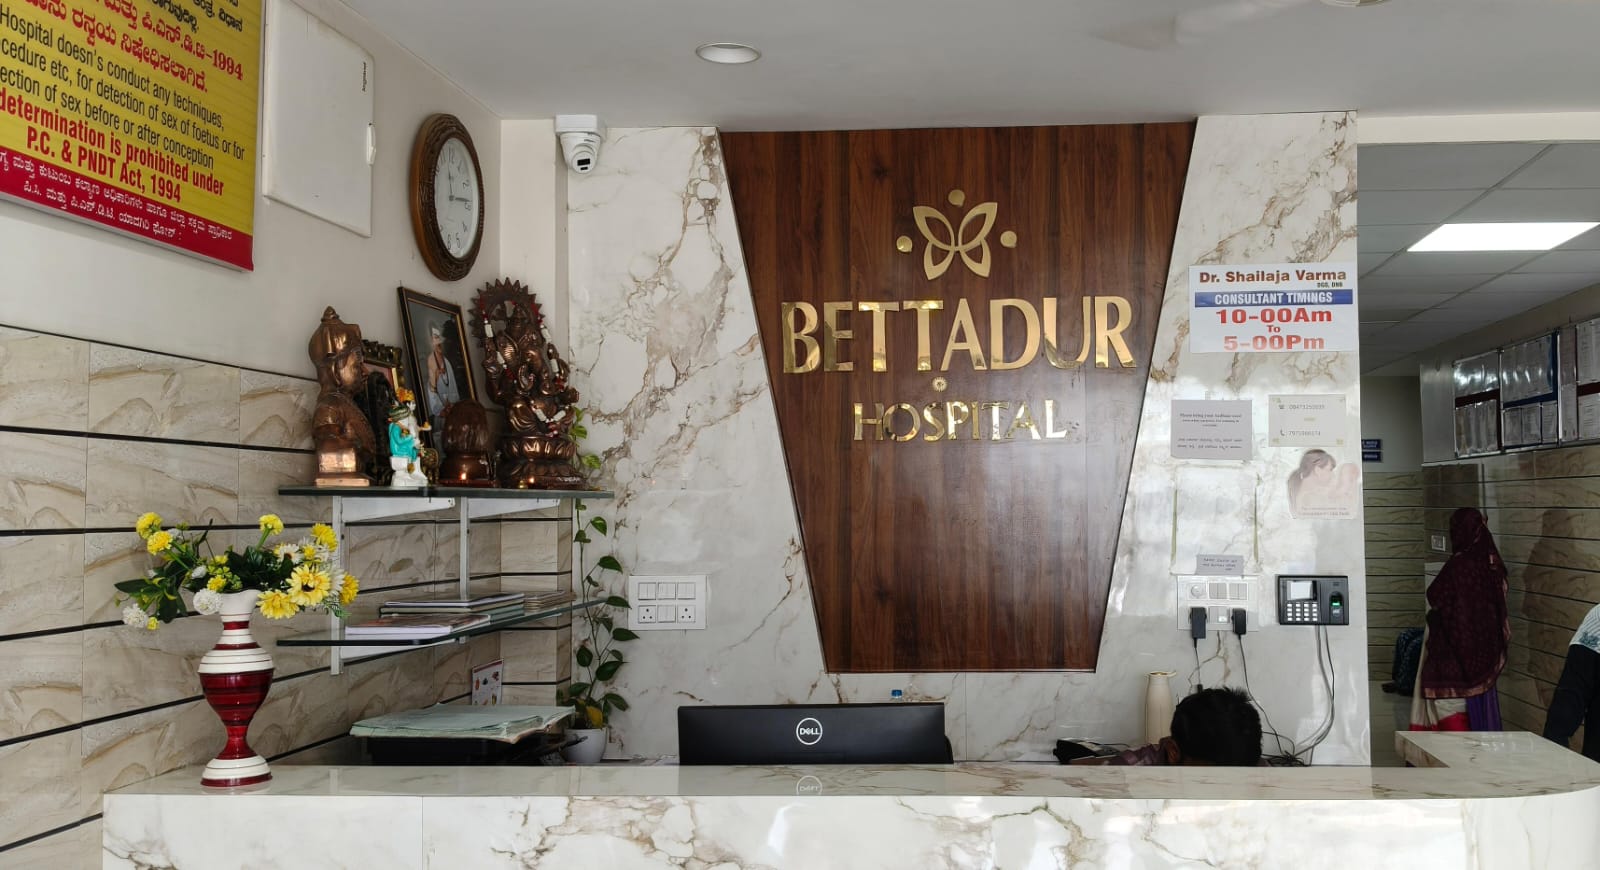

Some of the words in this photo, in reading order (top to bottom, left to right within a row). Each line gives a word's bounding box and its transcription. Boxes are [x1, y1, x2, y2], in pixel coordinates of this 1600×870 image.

[0, 3, 53, 48] Hospital
[107, 60, 151, 94] conduct
[153, 84, 171, 105] any
[173, 88, 225, 132] techniques,
[0, 38, 47, 72] cedure
[51, 59, 73, 87] etc,
[77, 68, 93, 92] for
[96, 79, 146, 116] detection
[149, 103, 159, 120] of
[161, 111, 178, 130] sex
[180, 116, 191, 135] of
[192, 122, 219, 148] foetus
[222, 140, 231, 154] or
[232, 140, 245, 160] for
[45, 84, 57, 104] of
[61, 92, 82, 114] sex
[85, 98, 120, 131] before
[123, 119, 135, 135] or
[138, 124, 160, 147] after
[163, 137, 214, 170] conception
[26, 126, 55, 158] P.C.
[61, 140, 72, 163] &
[78, 145, 116, 179] PNDT
[119, 161, 146, 194] Act,
[151, 175, 181, 203] 1994
[110, 132, 121, 156] is
[126, 142, 188, 182] prohibited
[192, 169, 224, 196] under
[1200, 271, 1220, 283] Dr.
[1225, 270, 1290, 284] Shailaja
[1295, 269, 1347, 281] Varma
[1215, 292, 1283, 305] CONSULTANT
[1285, 291, 1333, 304] TIMINGS
[781, 296, 1137, 374] BETTADUR
[1216, 307, 1333, 324] 10-00Am
[1266, 325, 1281, 333] To
[1224, 334, 1325, 350] 5-00Pm
[853, 399, 1067, 442] HOSPITAL
[799, 727, 820, 735] DELL
